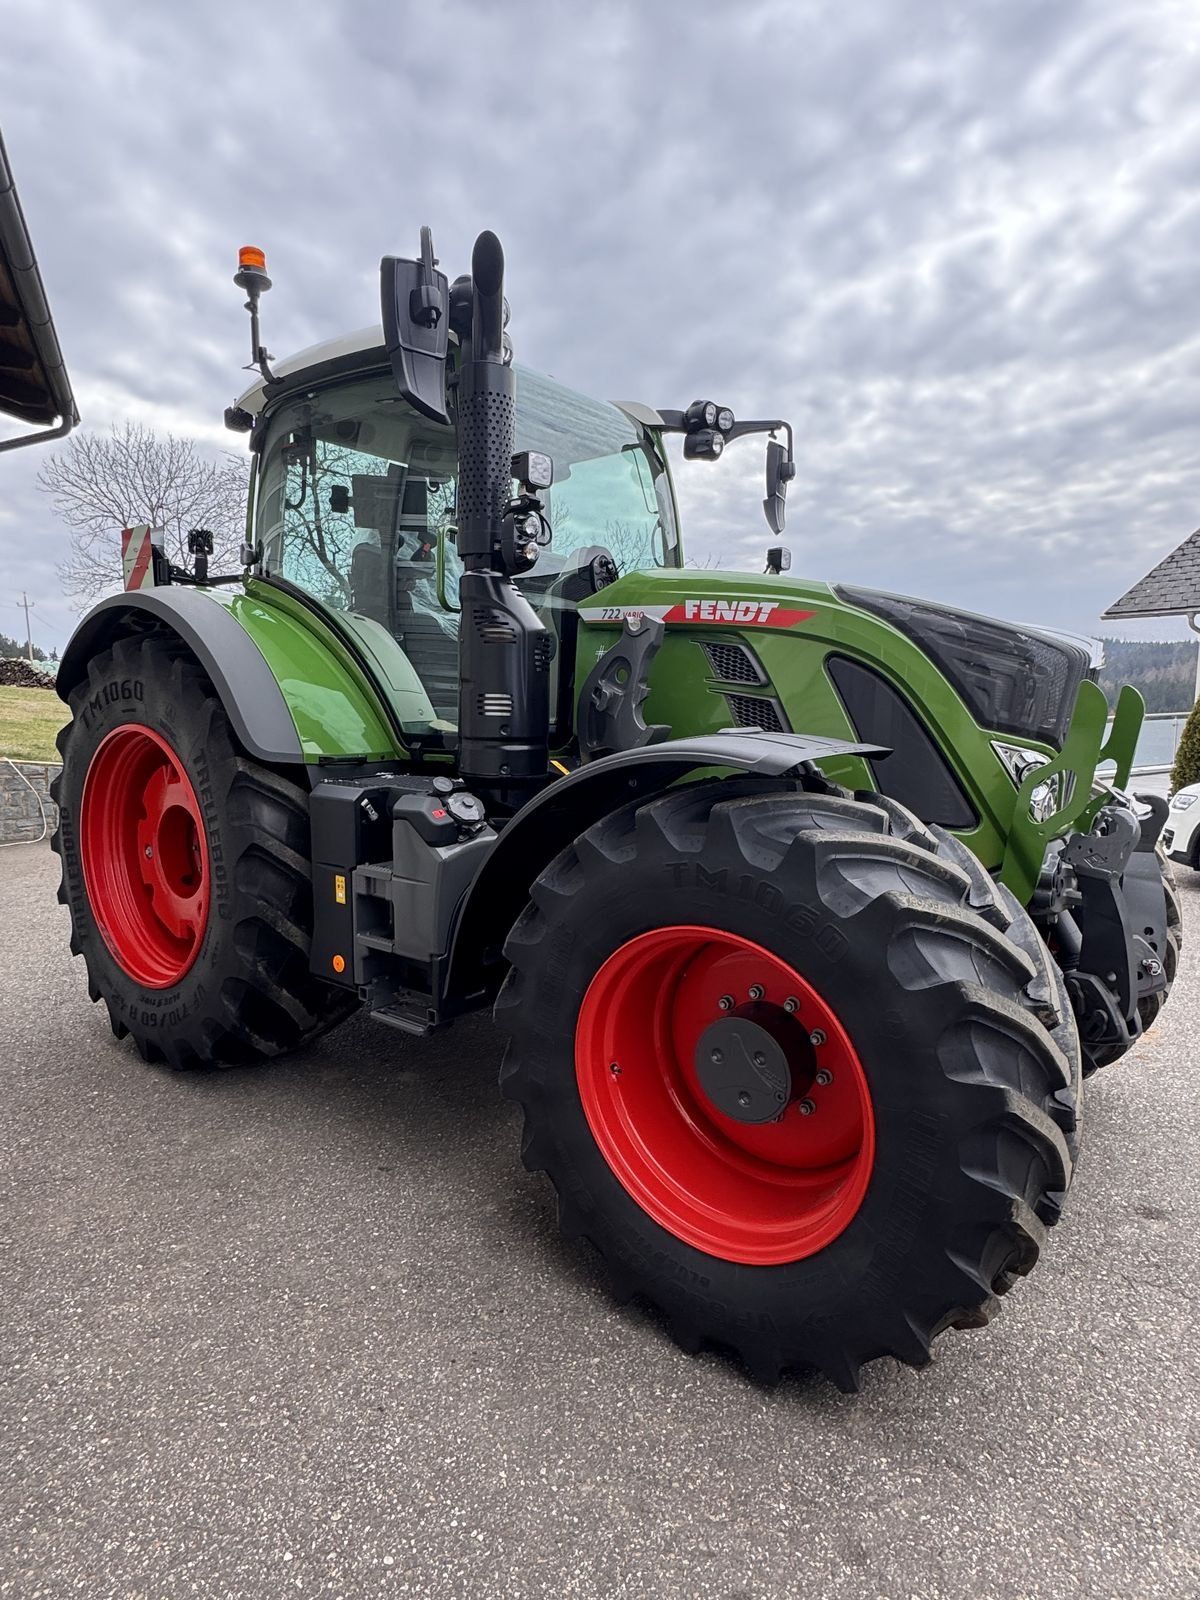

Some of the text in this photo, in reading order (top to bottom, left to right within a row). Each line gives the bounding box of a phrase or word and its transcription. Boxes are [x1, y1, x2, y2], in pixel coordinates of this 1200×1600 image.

[602, 608, 621, 619] 722
[684, 600, 780, 623] FENDT
[663, 859, 850, 964] TM1060
